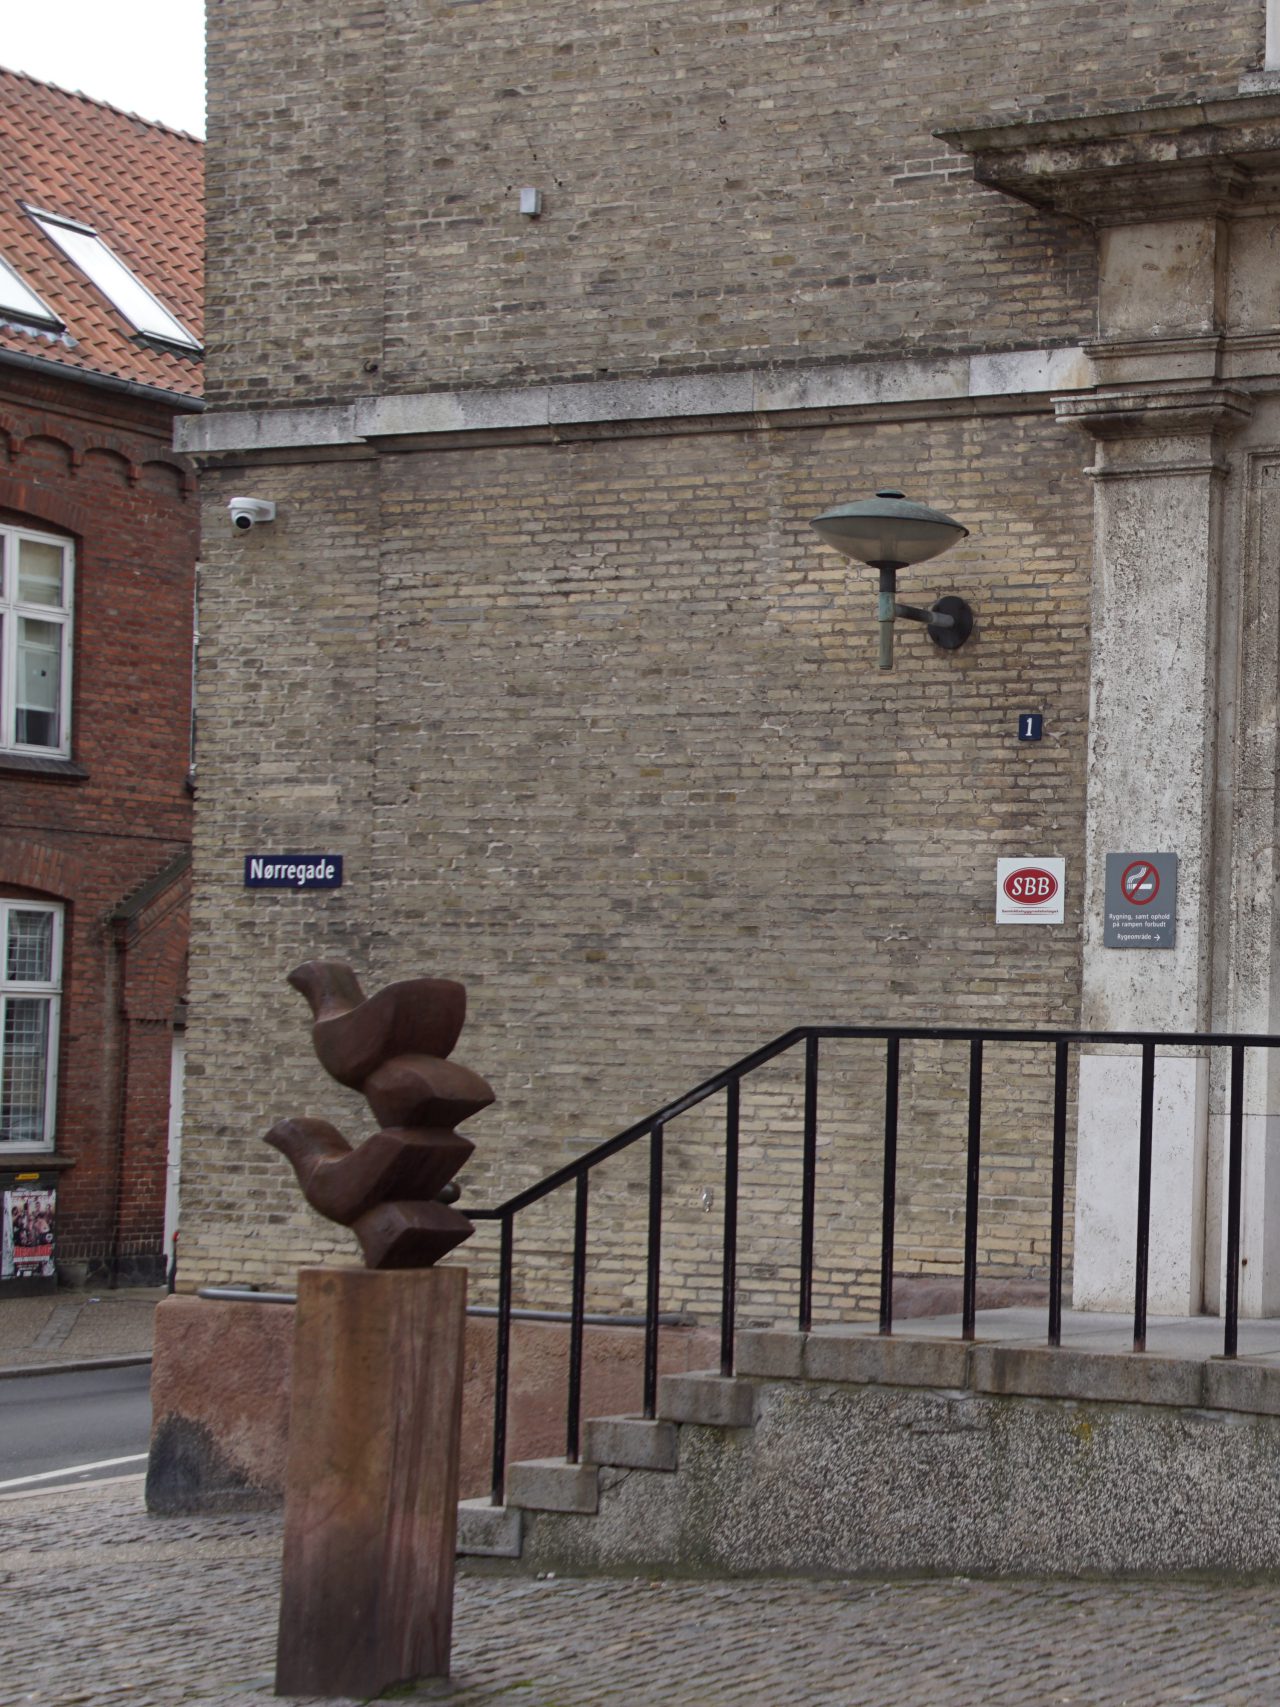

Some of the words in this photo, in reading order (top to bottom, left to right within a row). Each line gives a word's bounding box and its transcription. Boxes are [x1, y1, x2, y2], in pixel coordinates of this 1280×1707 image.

[1025, 718, 1032, 736] 1
[250, 858, 335, 885] Nørregade
[1011, 876, 1050, 896] SBB
